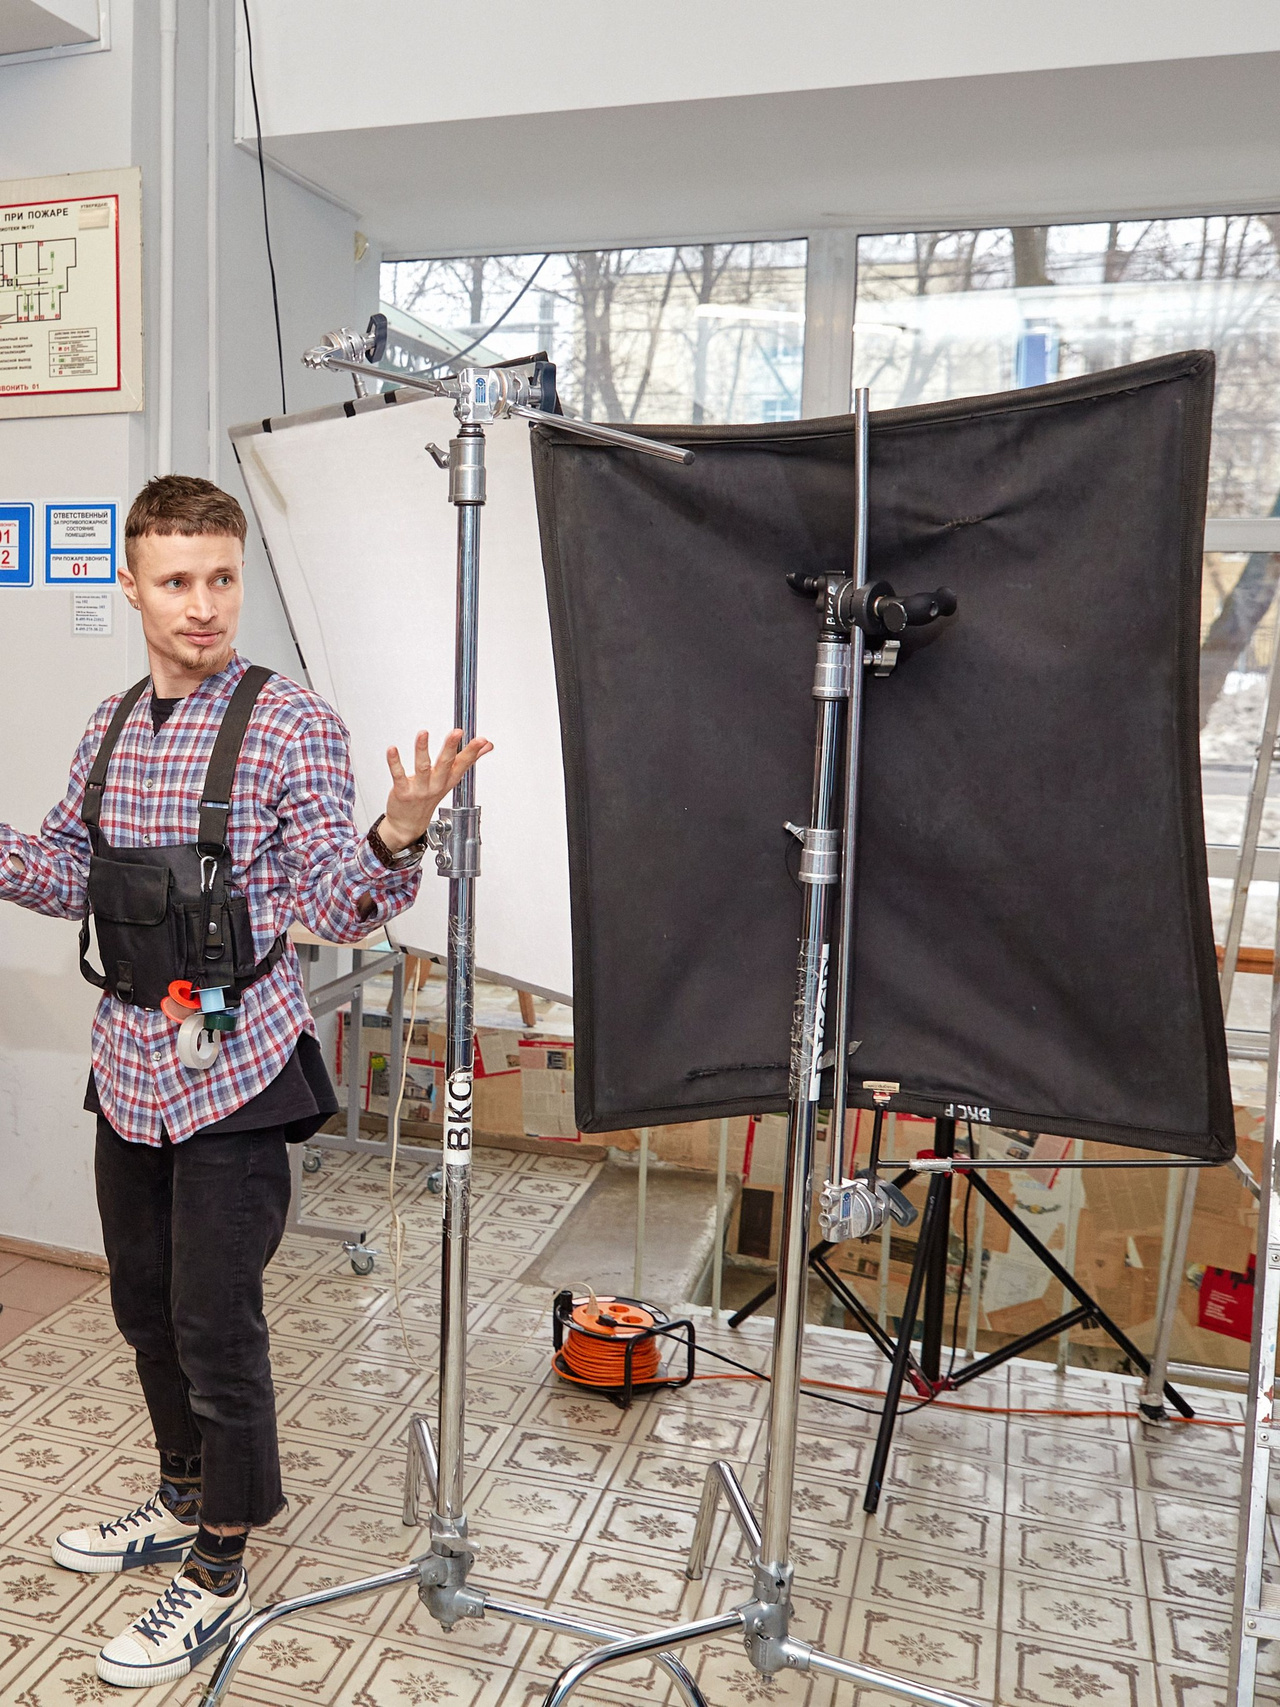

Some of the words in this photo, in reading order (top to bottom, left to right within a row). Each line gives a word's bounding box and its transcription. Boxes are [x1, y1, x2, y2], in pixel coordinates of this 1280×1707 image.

[4, 212, 24, 222] ПРИ
[28, 208, 69, 220] ПОЖАРЕ
[72, 562, 88, 576] 01
